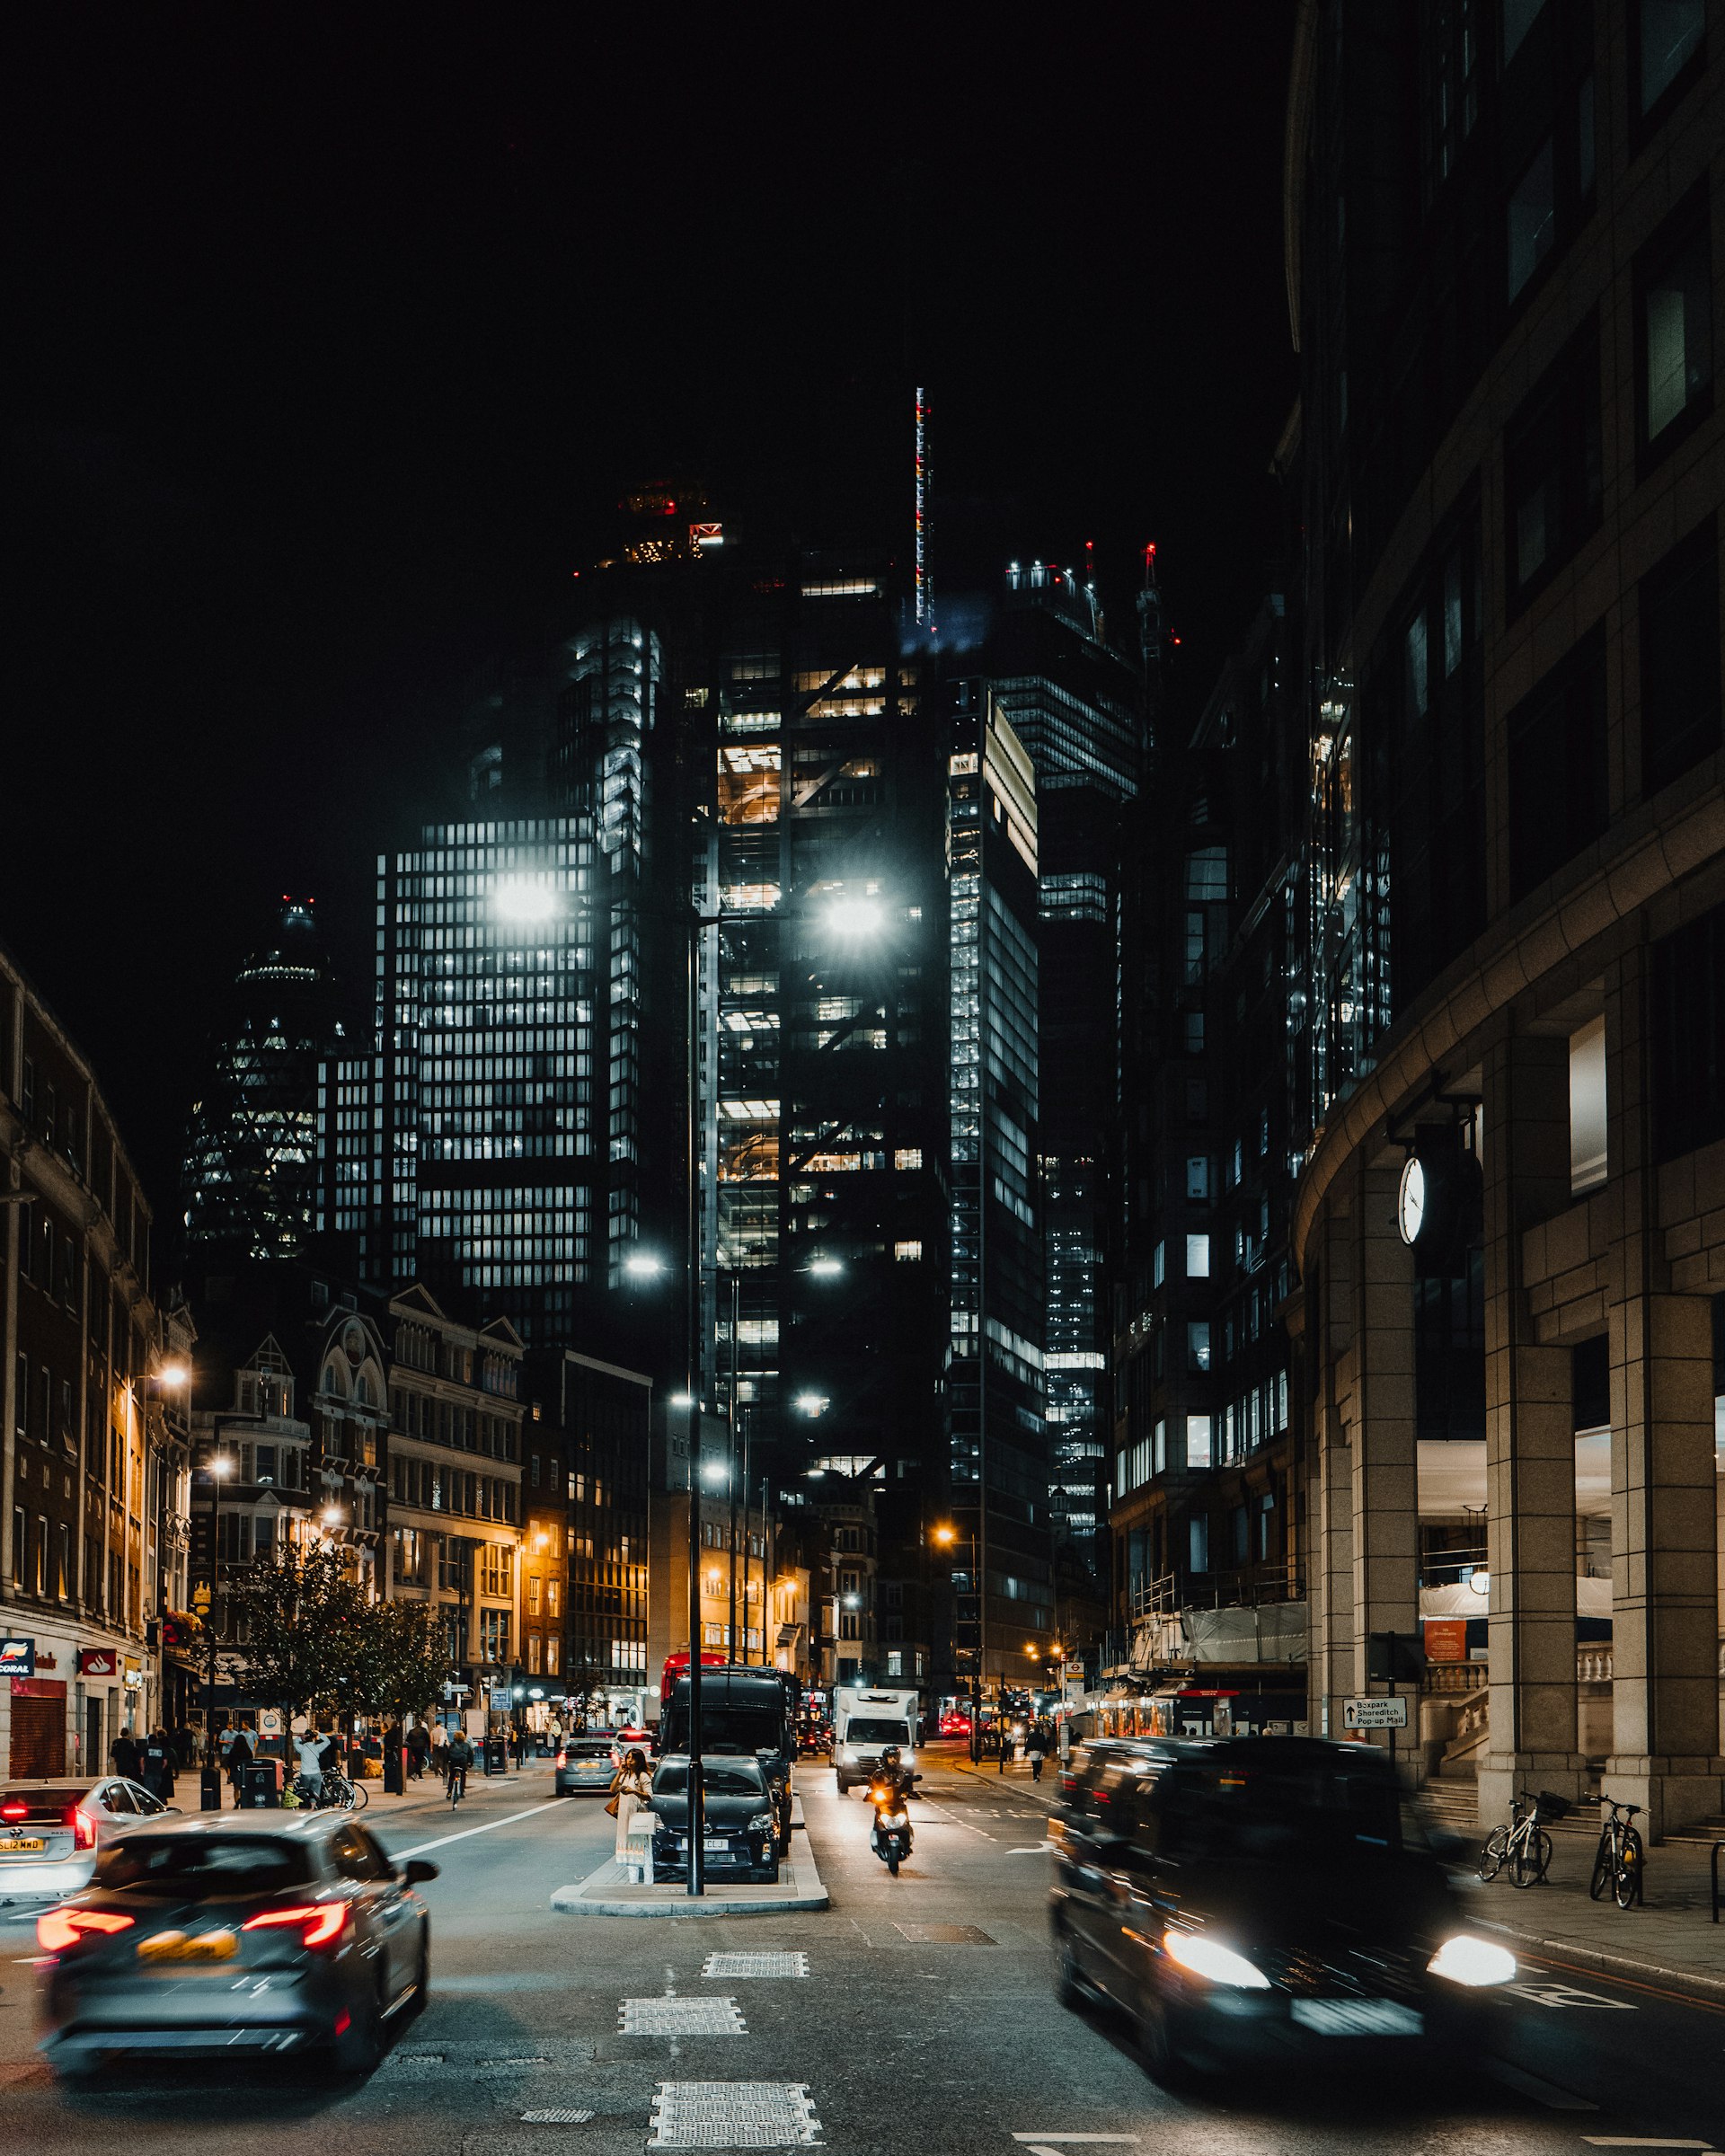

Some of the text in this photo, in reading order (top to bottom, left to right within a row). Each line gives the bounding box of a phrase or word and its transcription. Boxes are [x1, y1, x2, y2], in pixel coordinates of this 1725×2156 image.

[1061, 1654, 1066, 1662] E
[1358, 1709, 1399, 1717] Shoreditch
[707, 1840, 723, 1848] CLJ
